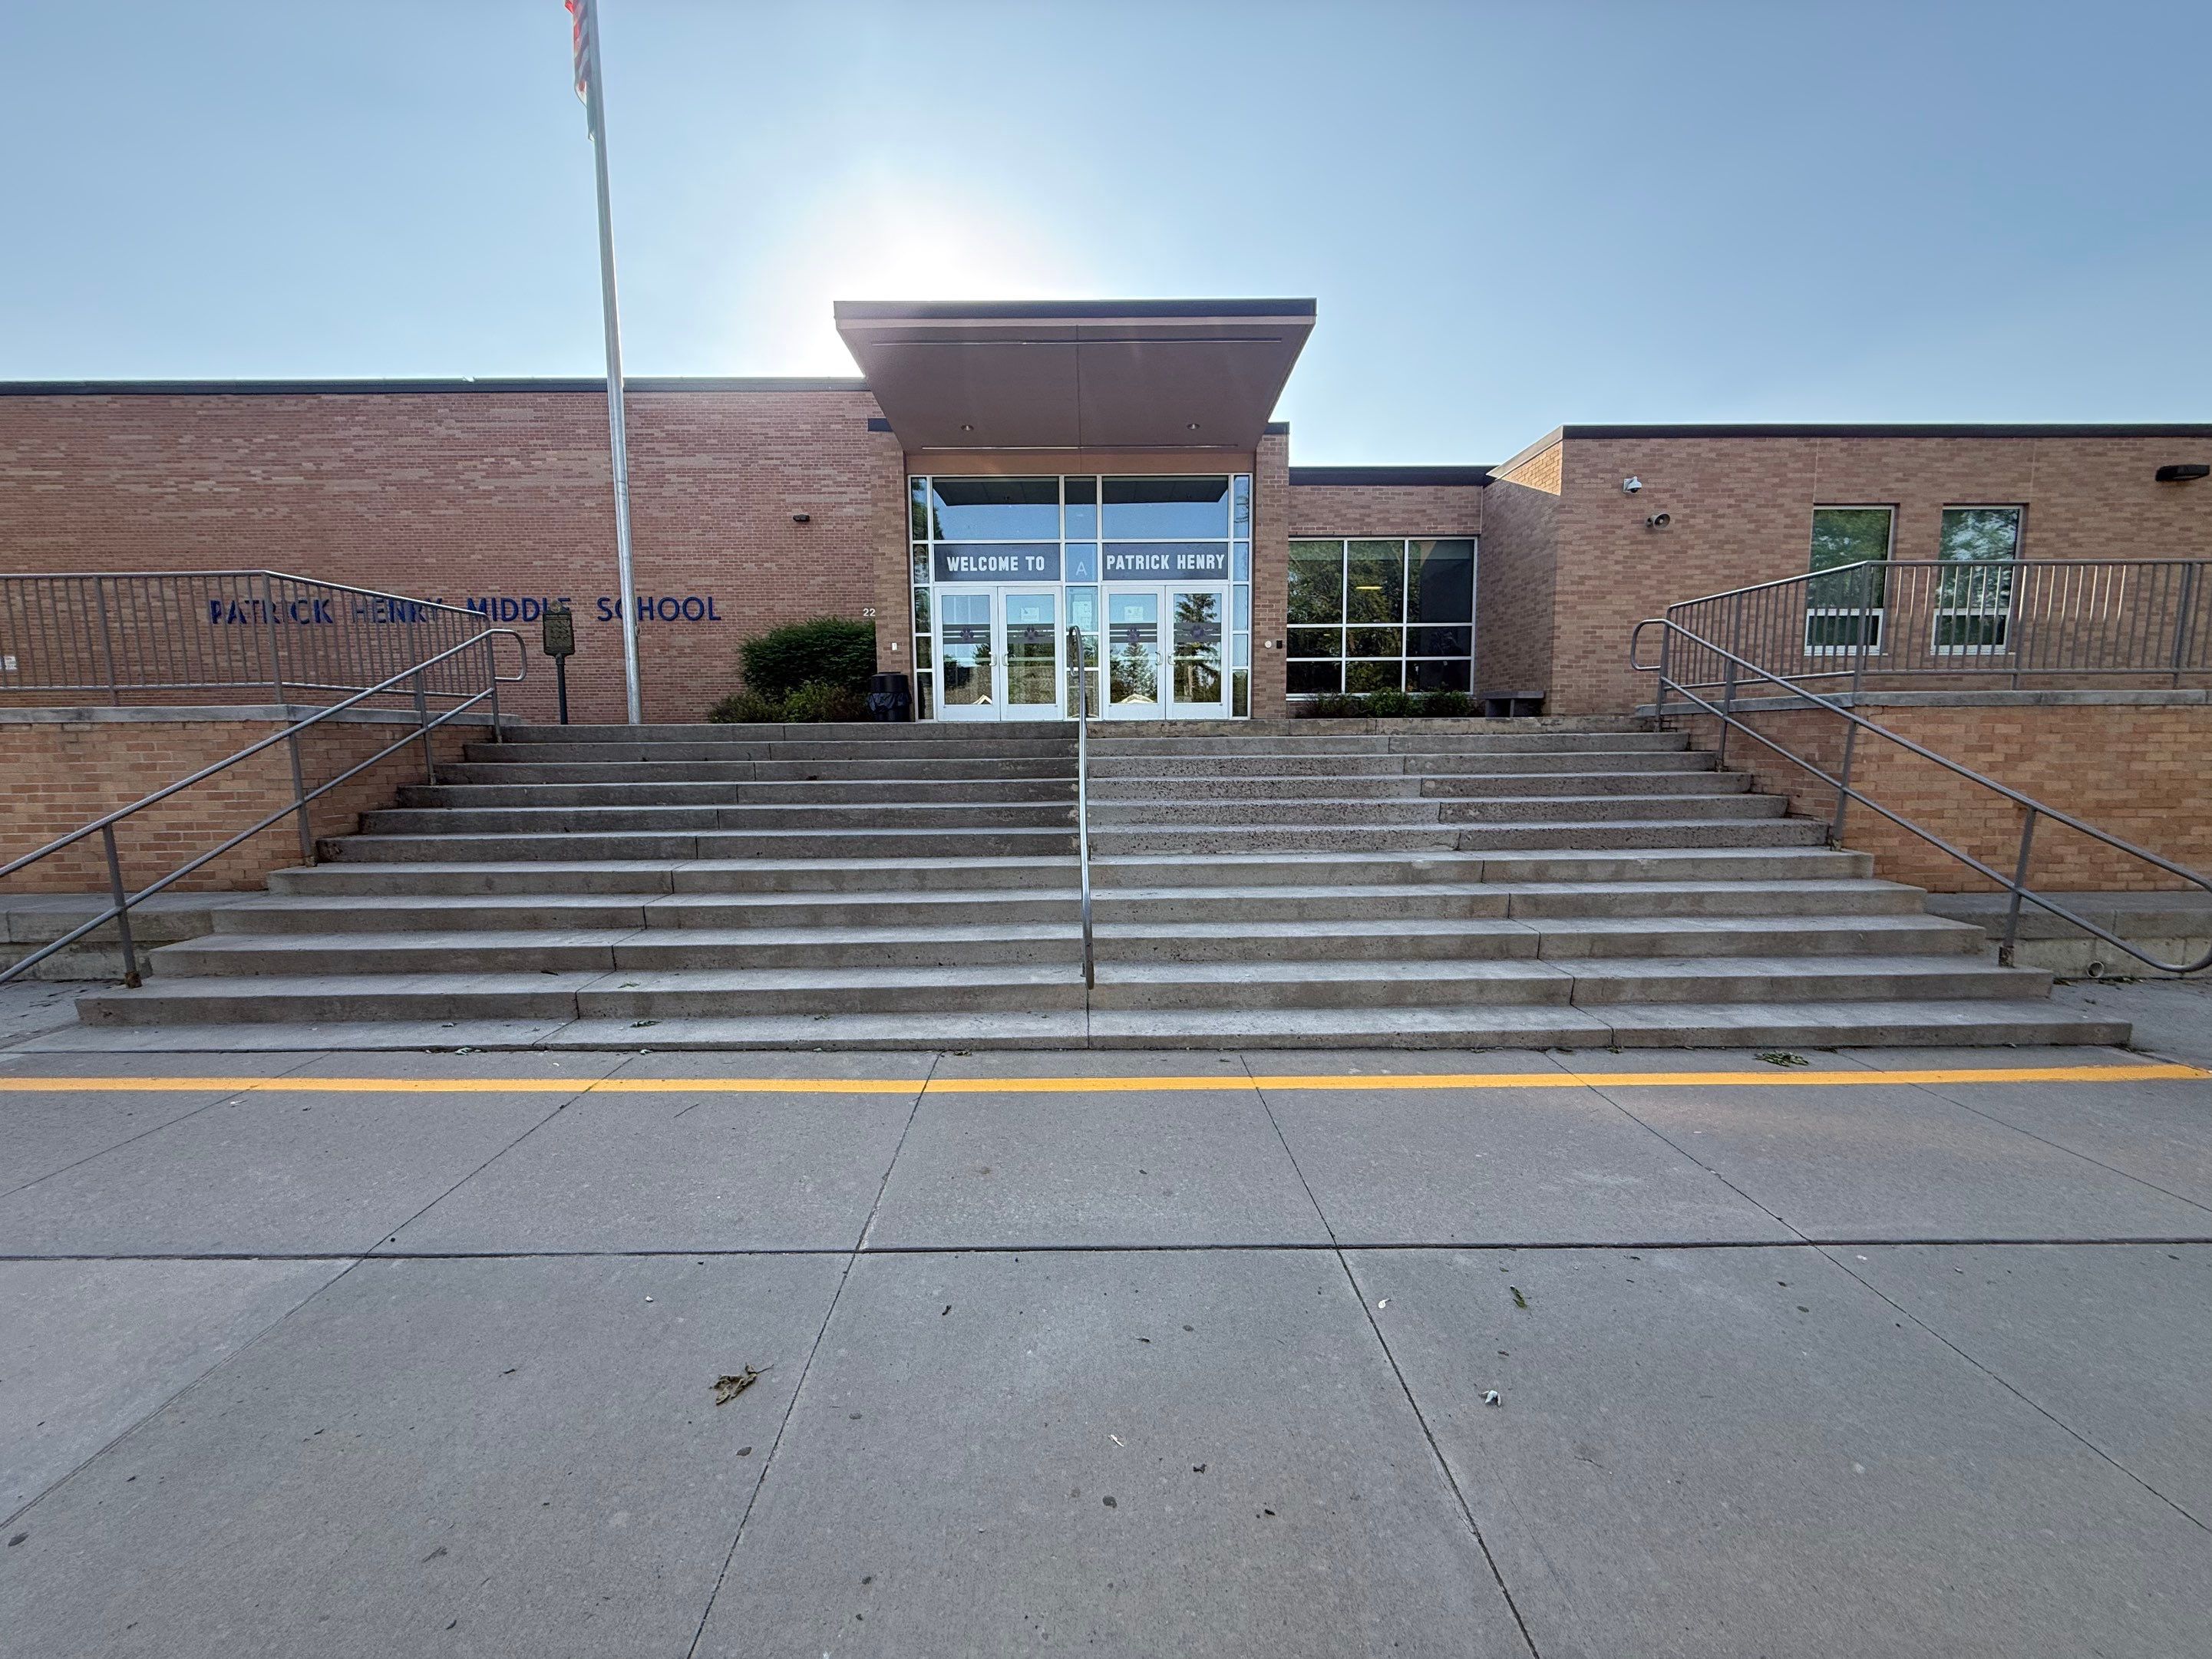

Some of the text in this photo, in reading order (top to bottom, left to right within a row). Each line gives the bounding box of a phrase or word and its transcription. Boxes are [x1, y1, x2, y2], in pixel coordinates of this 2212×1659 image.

[946, 556, 1045, 571] WELCOME TO
[1075, 562, 1088, 576] A
[1106, 553, 1225, 570] PATRICK HENRY
[210, 599, 333, 624] PATRCK
